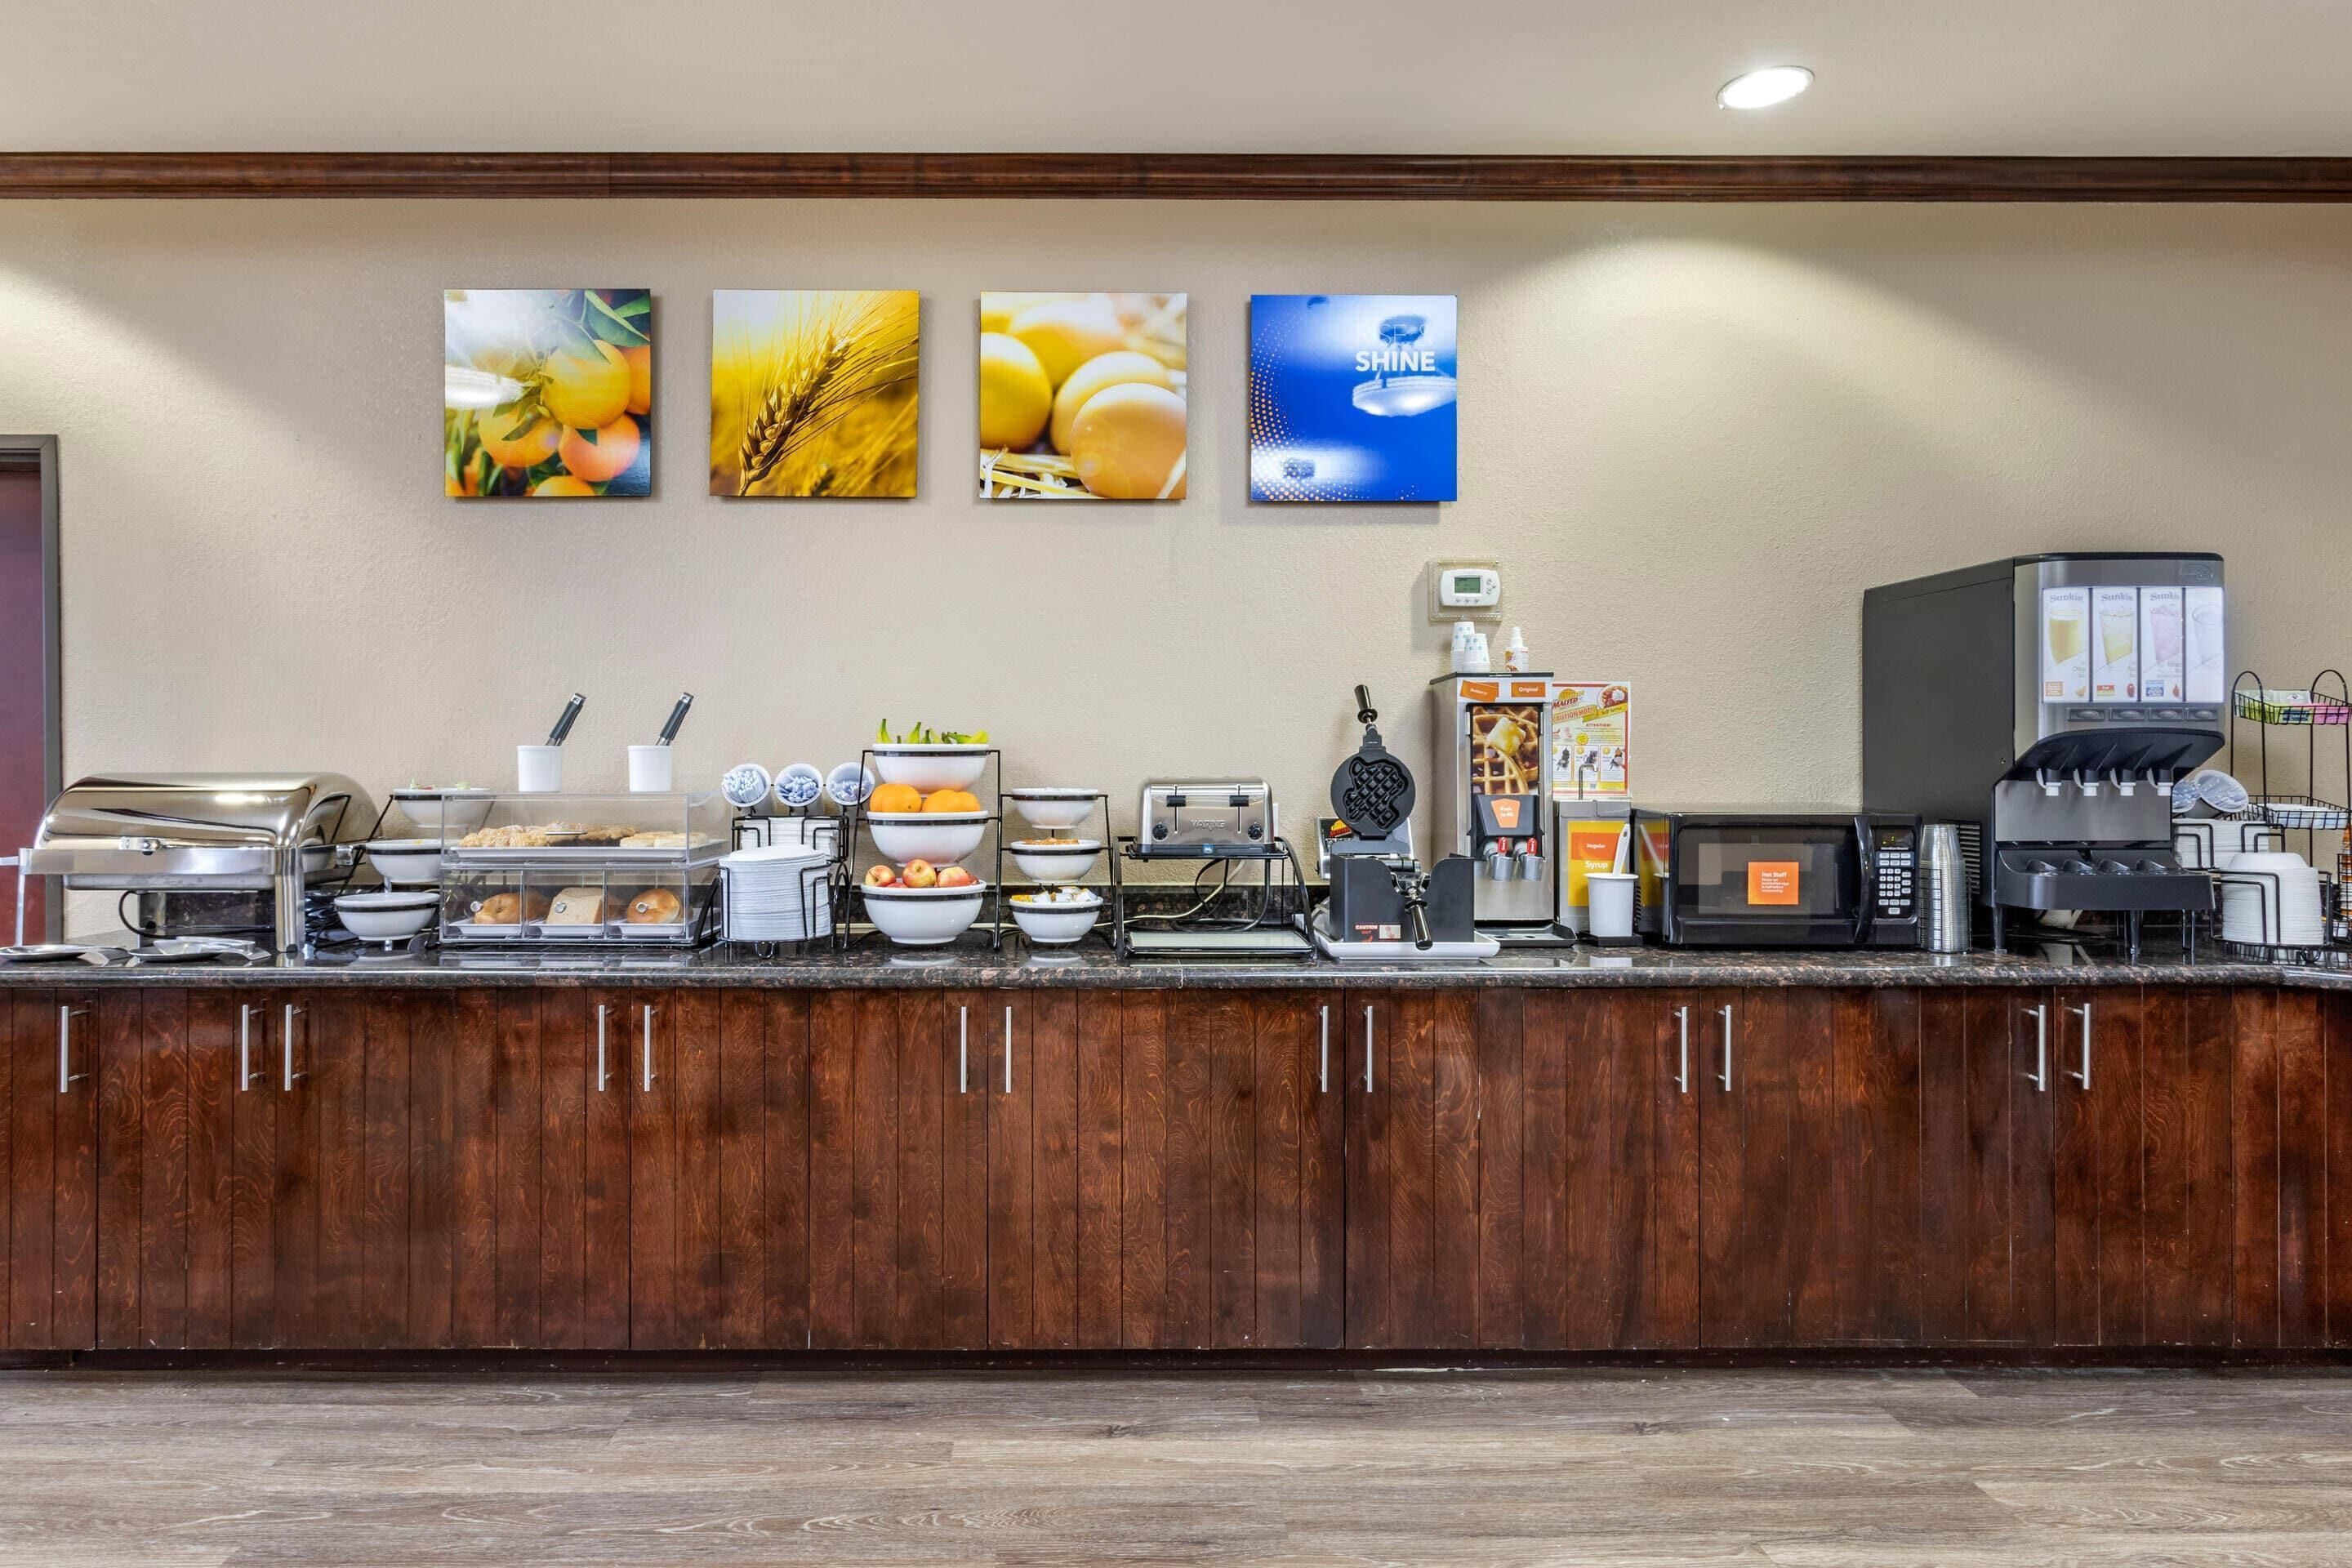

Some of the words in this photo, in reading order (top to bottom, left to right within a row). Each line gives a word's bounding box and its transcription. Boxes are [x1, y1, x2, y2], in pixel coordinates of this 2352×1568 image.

[1357, 323, 1406, 346] RISE
[1356, 350, 1436, 372] SHINE
[2150, 590, 2180, 601] Sunkis
[1579, 706, 1593, 716] HOT!
[1189, 818, 1226, 830] WARING
[1585, 860, 1608, 870] Syrup
